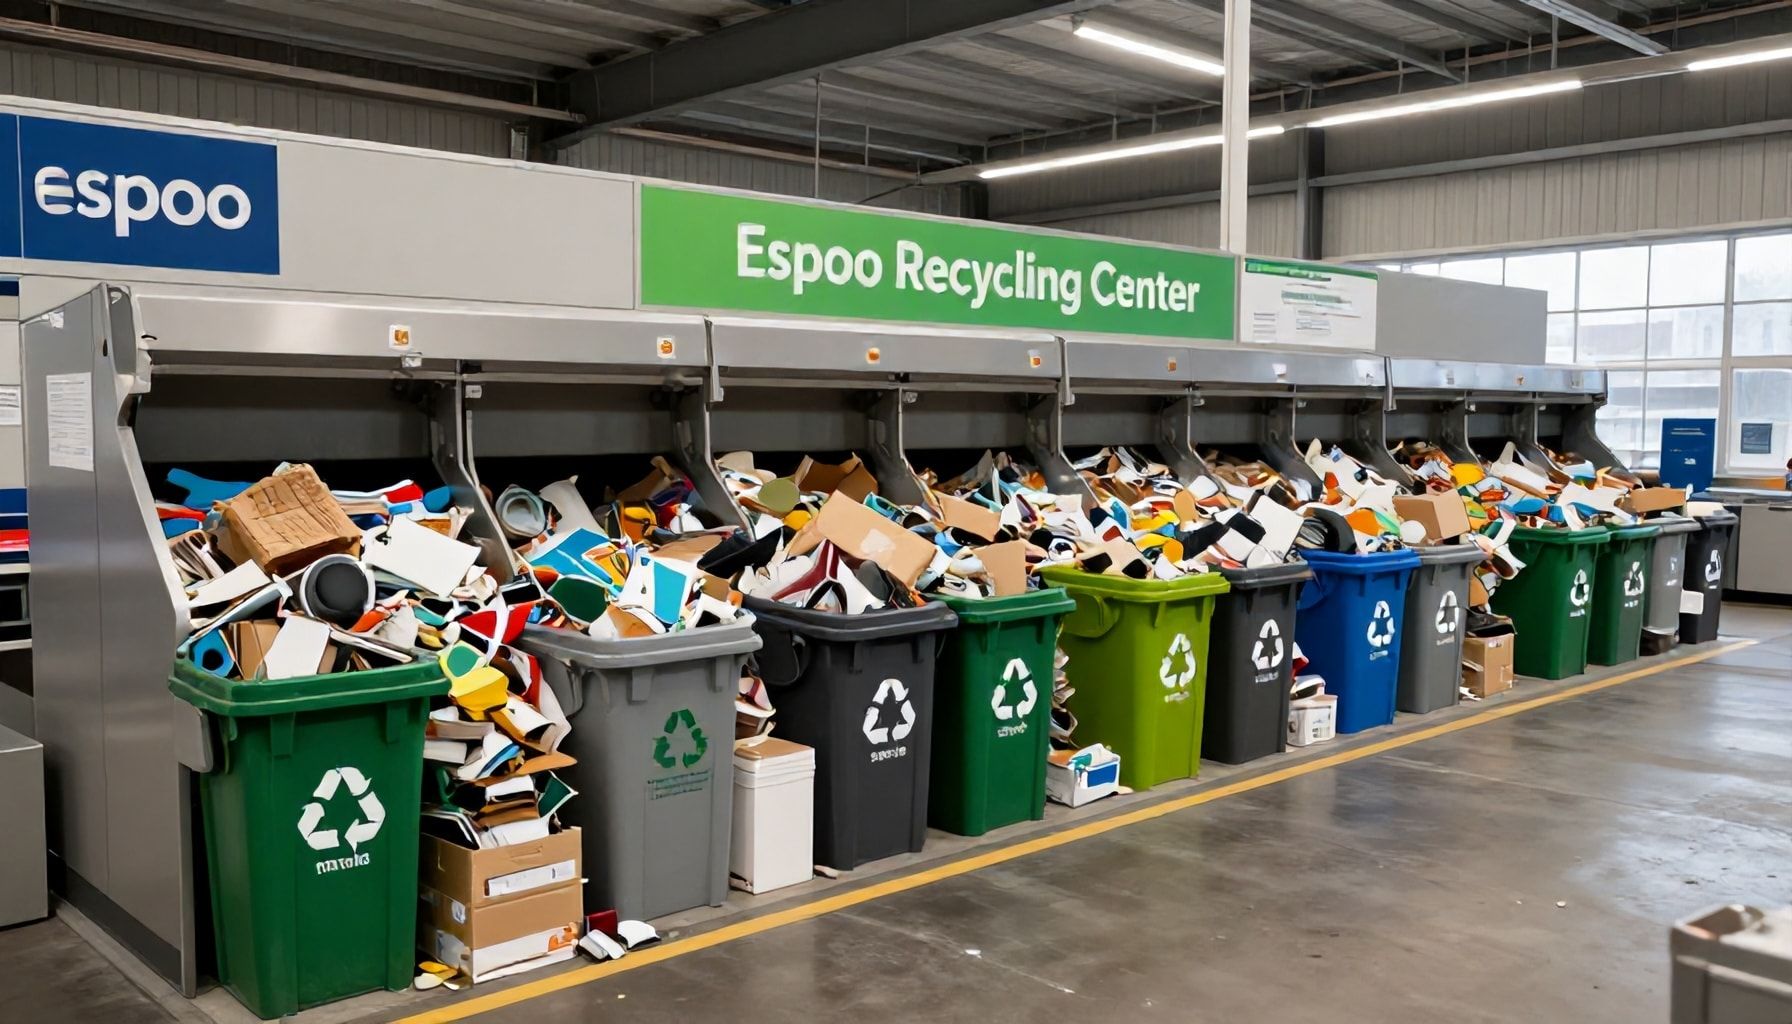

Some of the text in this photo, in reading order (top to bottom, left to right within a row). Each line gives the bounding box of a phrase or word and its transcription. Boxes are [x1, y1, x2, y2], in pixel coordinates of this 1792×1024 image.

[737, 222, 1200, 316] Espoo Recycling Center
